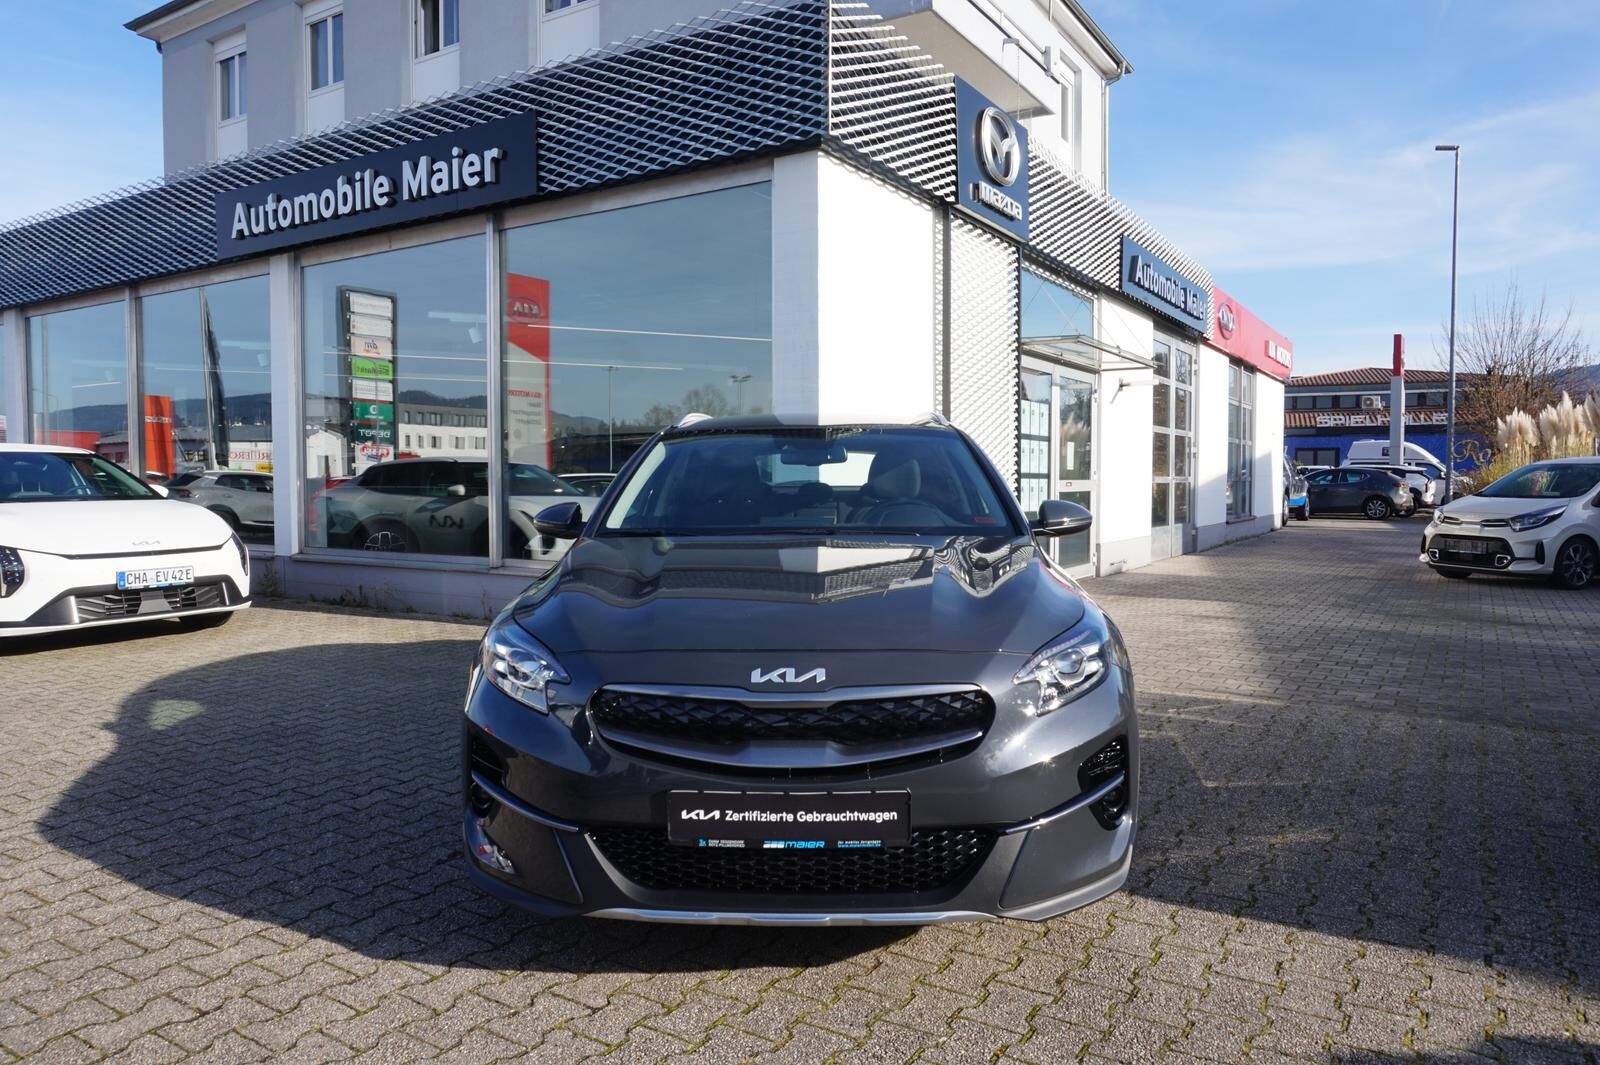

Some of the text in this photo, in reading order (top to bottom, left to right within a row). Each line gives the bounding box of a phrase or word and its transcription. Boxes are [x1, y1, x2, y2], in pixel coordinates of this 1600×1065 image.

[231, 147, 501, 240] Automobile Maier
[1135, 255, 1206, 320] Automobile Maier
[1316, 412, 1448, 427] SPIELHLLE
[126, 572, 149, 585] CHA
[750, 667, 826, 684] KIA
[681, 808, 898, 824] KIA Zertifizierte Gebrauchtwagen
